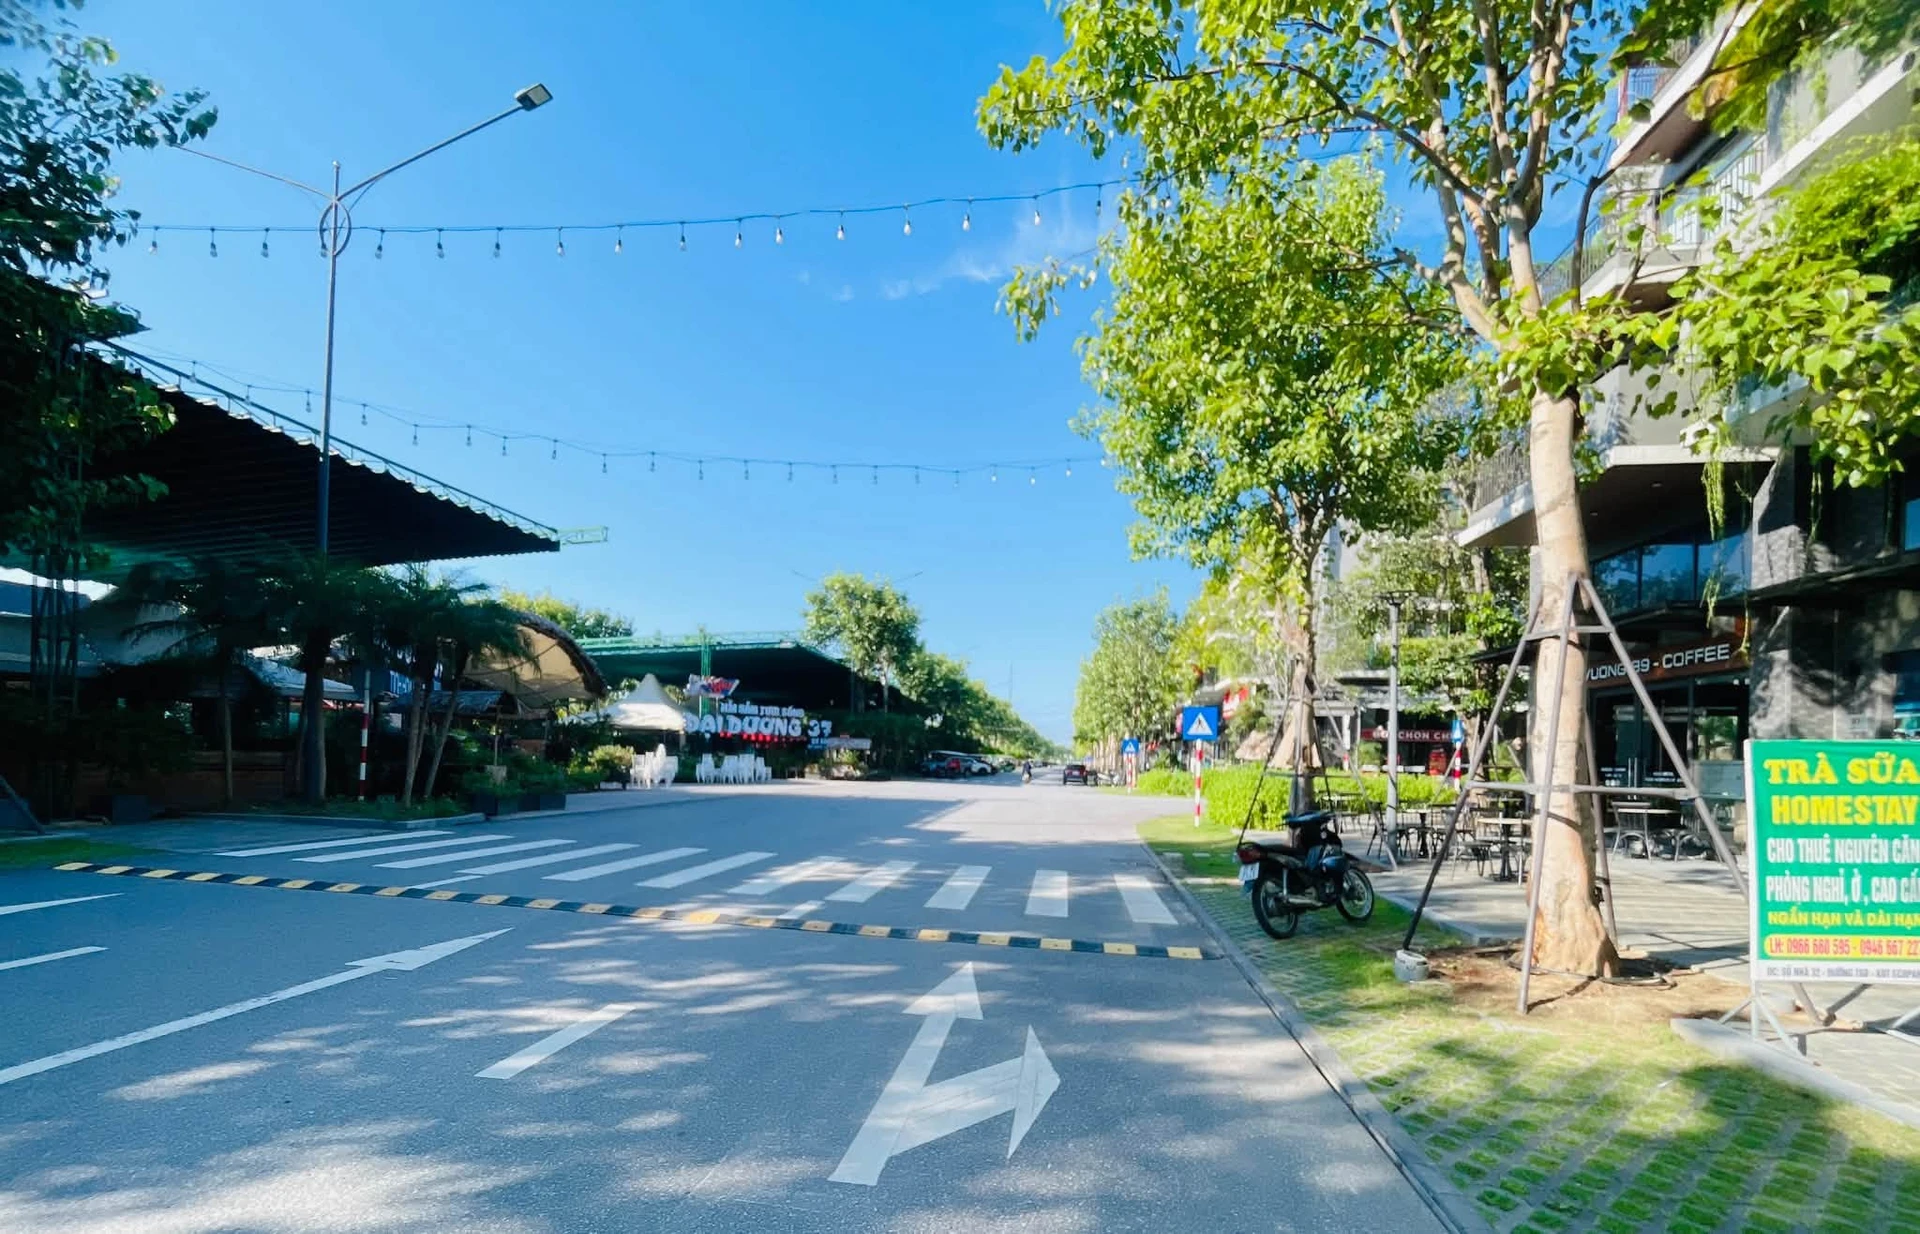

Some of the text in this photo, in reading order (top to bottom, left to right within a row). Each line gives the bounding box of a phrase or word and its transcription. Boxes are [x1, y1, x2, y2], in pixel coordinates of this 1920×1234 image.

[1662, 644, 1730, 669] COFFEE
[808, 720, 832, 737] 37
[1763, 751, 1920, 784] TRÀ SỮA
[1771, 795, 1919, 825] HOMESTAY
[1766, 837, 1794, 863] CHO
[1797, 833, 1831, 863] THUÊ
[1834, 833, 1889, 863] NGUYÊN
[1766, 870, 1809, 902] PHÒNG
[1871, 876, 1898, 903] CAO
[1812, 912, 1841, 929] HẠN
[1844, 909, 1864, 926] VÀ
[1867, 909, 1891, 926] DÀI
